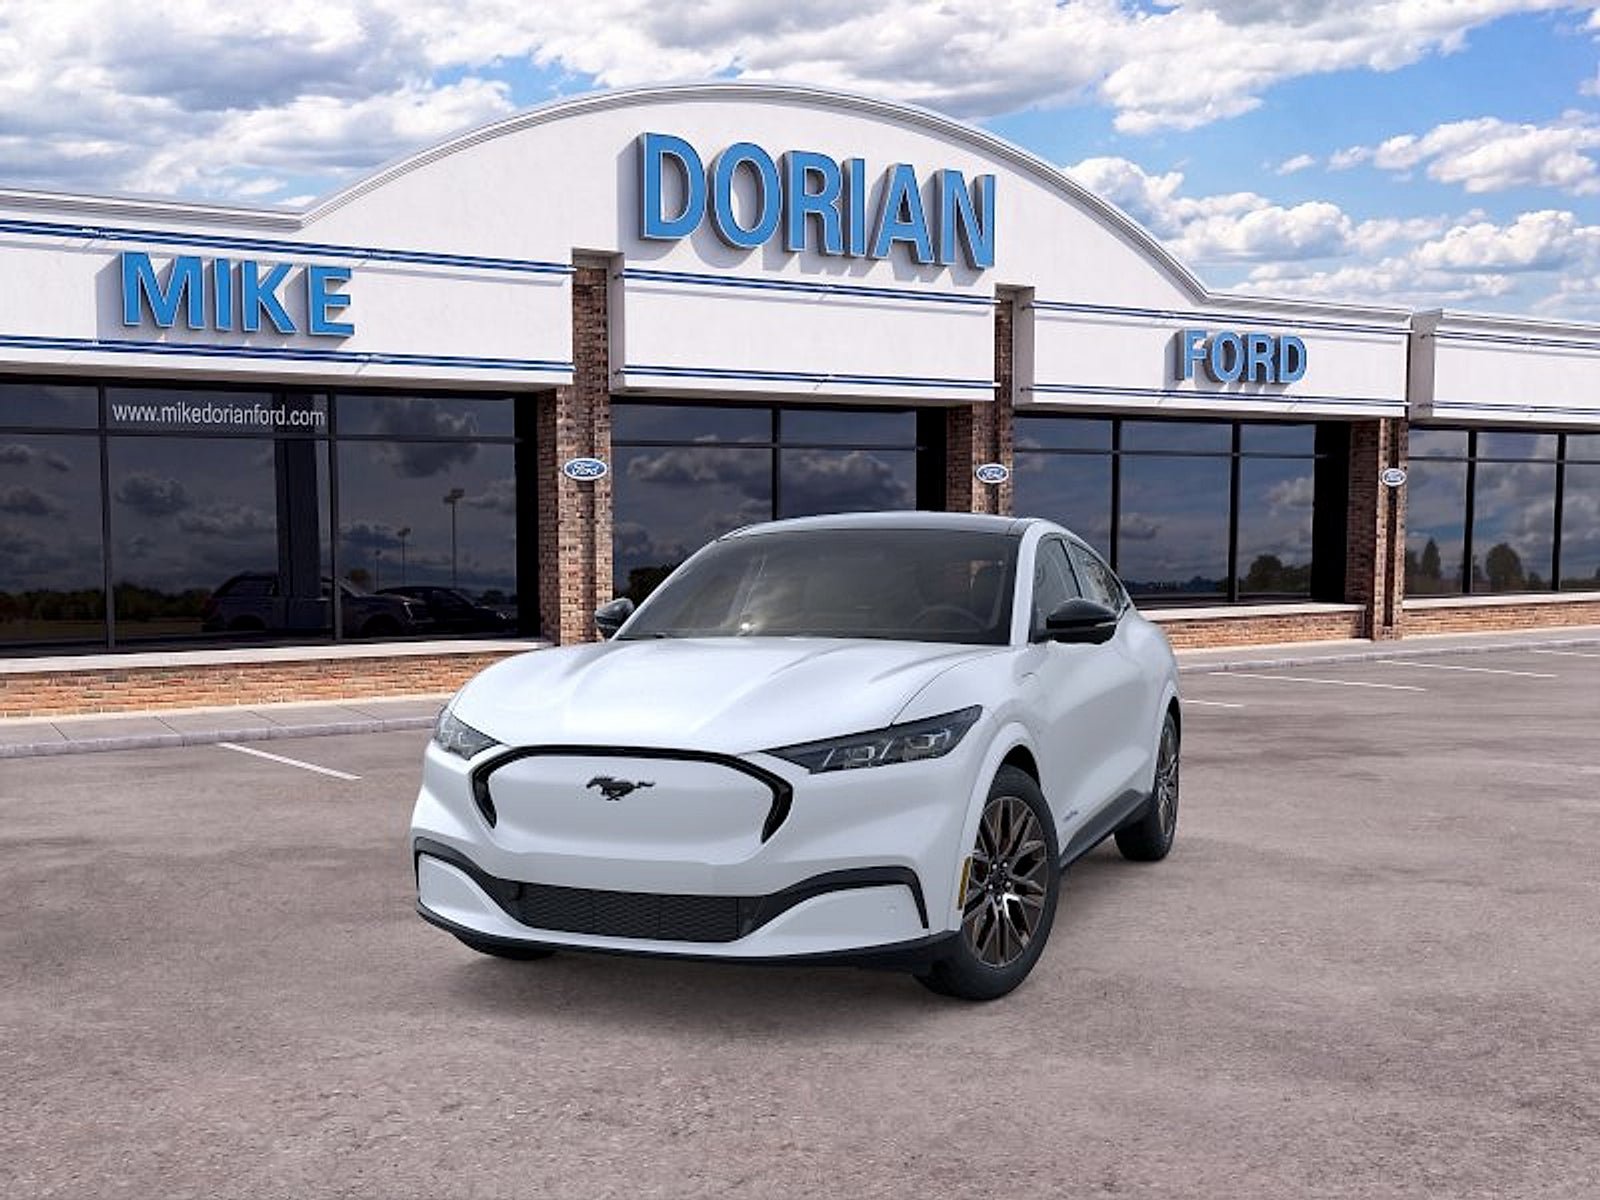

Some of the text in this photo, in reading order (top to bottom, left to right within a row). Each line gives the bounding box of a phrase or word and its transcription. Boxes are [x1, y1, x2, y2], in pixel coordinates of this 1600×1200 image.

[639, 131, 996, 270] DORIAN
[121, 251, 356, 338] MIKE
[1178, 328, 1308, 384] FORD
[111, 401, 326, 427] www.mikedorianford.com
